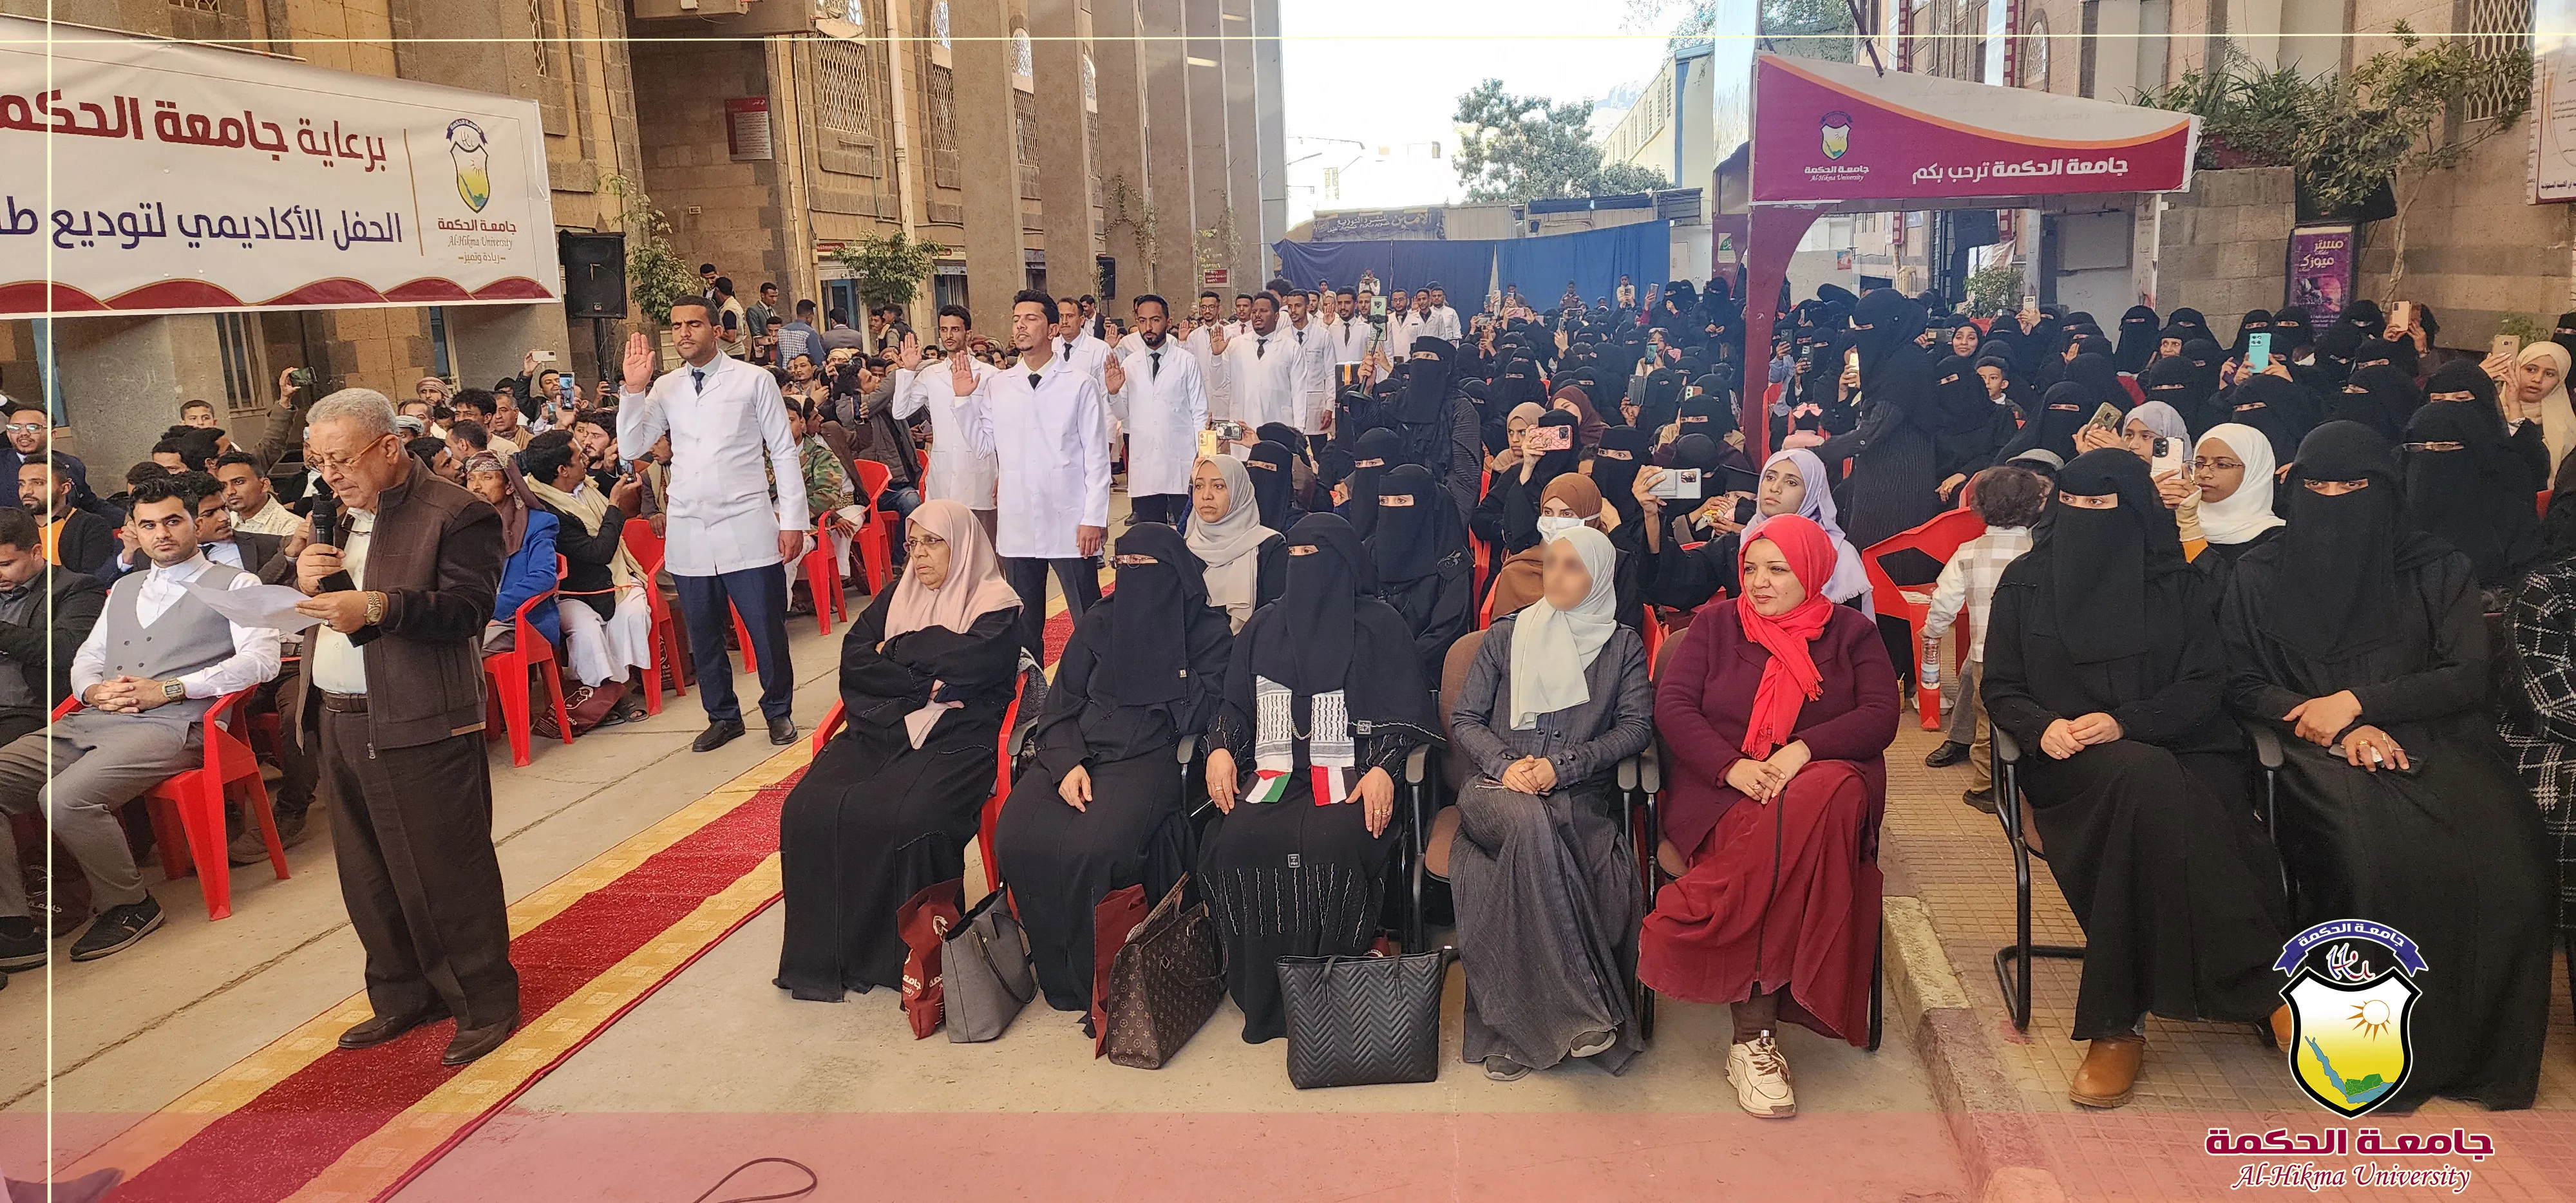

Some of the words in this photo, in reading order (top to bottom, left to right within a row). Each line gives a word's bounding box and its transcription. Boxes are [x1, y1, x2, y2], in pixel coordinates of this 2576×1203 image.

[0, 90, 144, 140] الحكم
[155, 100, 289, 161] جامعة
[297, 118, 386, 172] برعاية
[1838, 166, 1870, 174] جامعة
[1913, 163, 1943, 184] بكم
[1948, 162, 1989, 183] ترحب
[1993, 159, 2063, 176] الحكمة
[2067, 157, 2128, 176] جامعة
[52, 202, 166, 249] لتوديع
[178, 205, 323, 249] الأكاديمي
[334, 211, 402, 251] الحفل
[438, 218, 478, 231] الحكمة
[480, 220, 516, 235] جامعة
[448, 234, 479, 248] Al-Hikma
[482, 236, 512, 250] University
[903, 974, 922, 990] جامع
